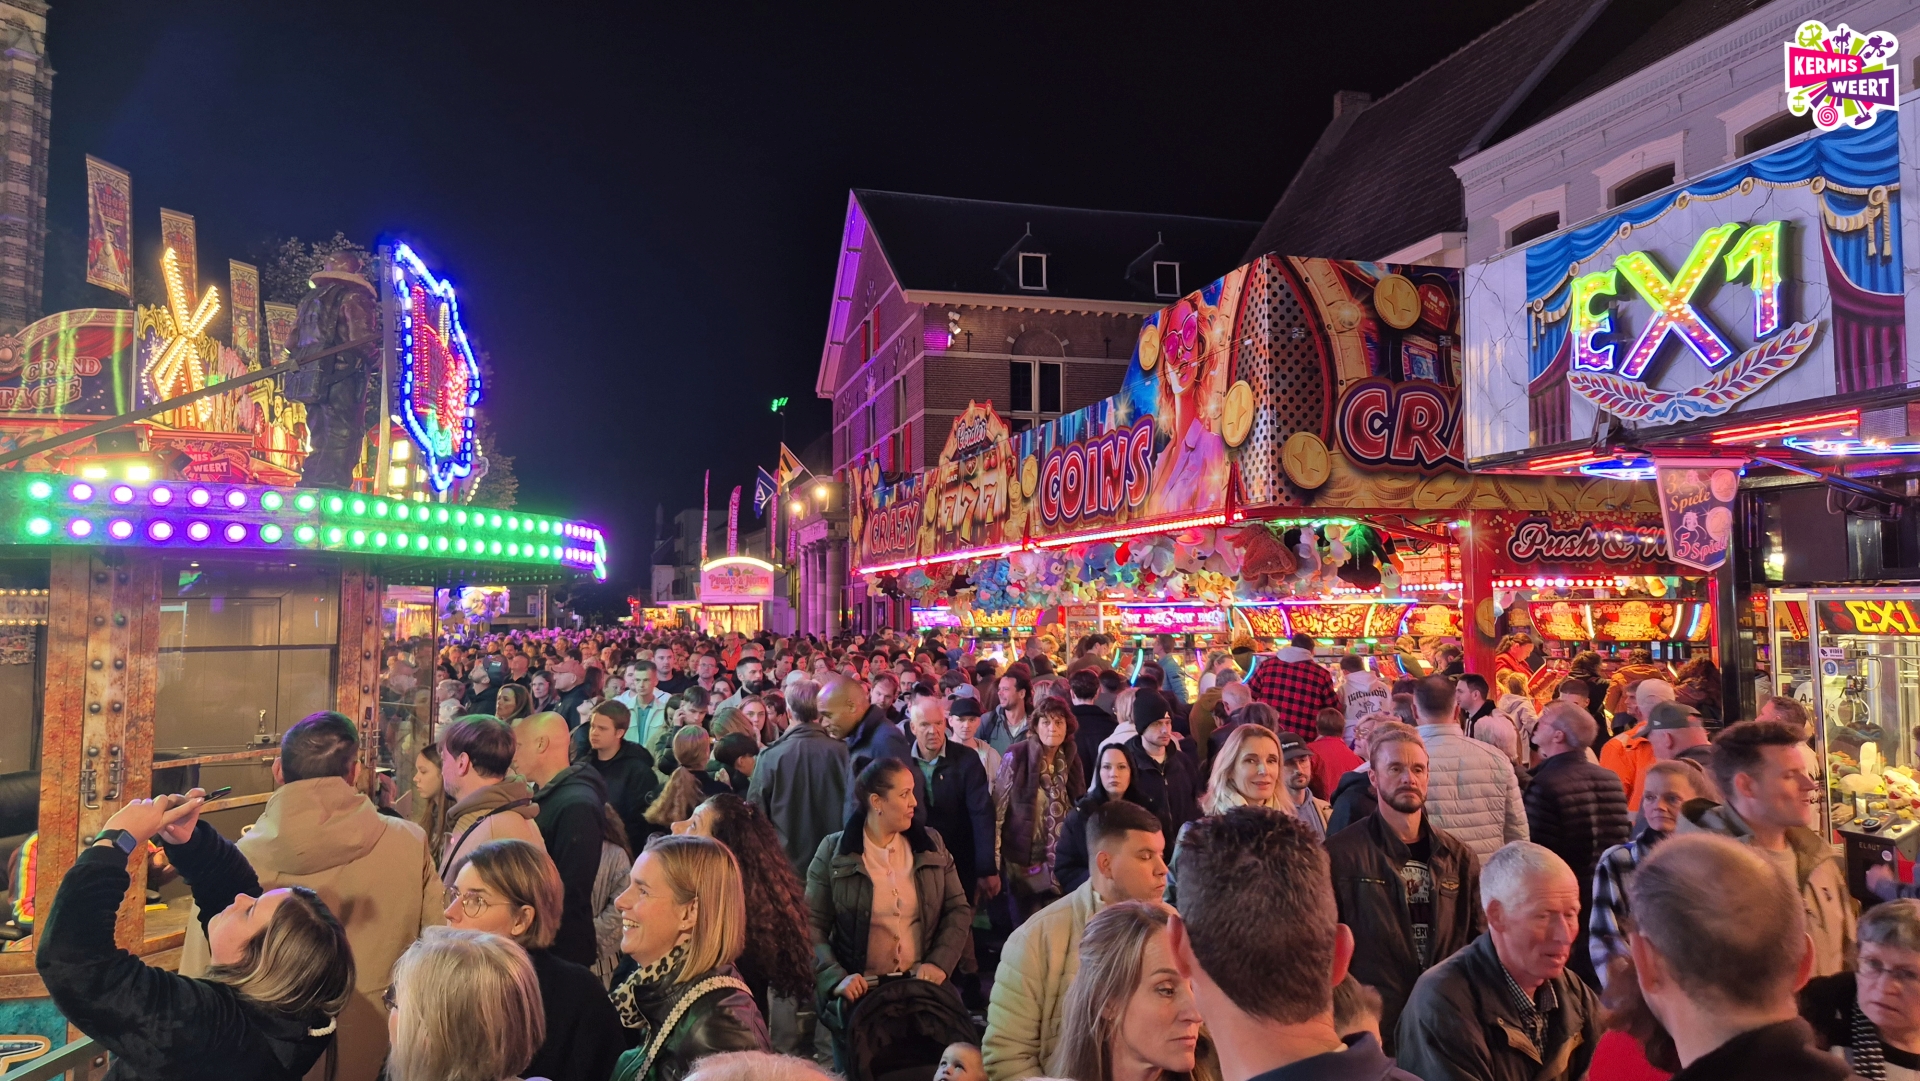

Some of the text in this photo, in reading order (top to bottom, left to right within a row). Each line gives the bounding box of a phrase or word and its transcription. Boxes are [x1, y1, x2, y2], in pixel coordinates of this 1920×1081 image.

[1570, 219, 1784, 380] EX1
[24, 357, 101, 381] GRAND
[192, 461, 228, 473] WEERT
[945, 474, 959, 485] BAR
[1041, 425, 1153, 521] COINS
[1665, 473, 1678, 494] 3
[1669, 487, 1711, 514] Spiele
[870, 500, 920, 554] CRAZY
[1512, 522, 1600, 558] Push
[1603, 527, 1635, 558] &
[1677, 532, 1691, 558] 5
[1291, 612, 1323, 633] FUN
[1327, 612, 1361, 632] CITY
[1844, 600, 1920, 633] EX1
[1858, 841, 1881, 851] ELAUT
